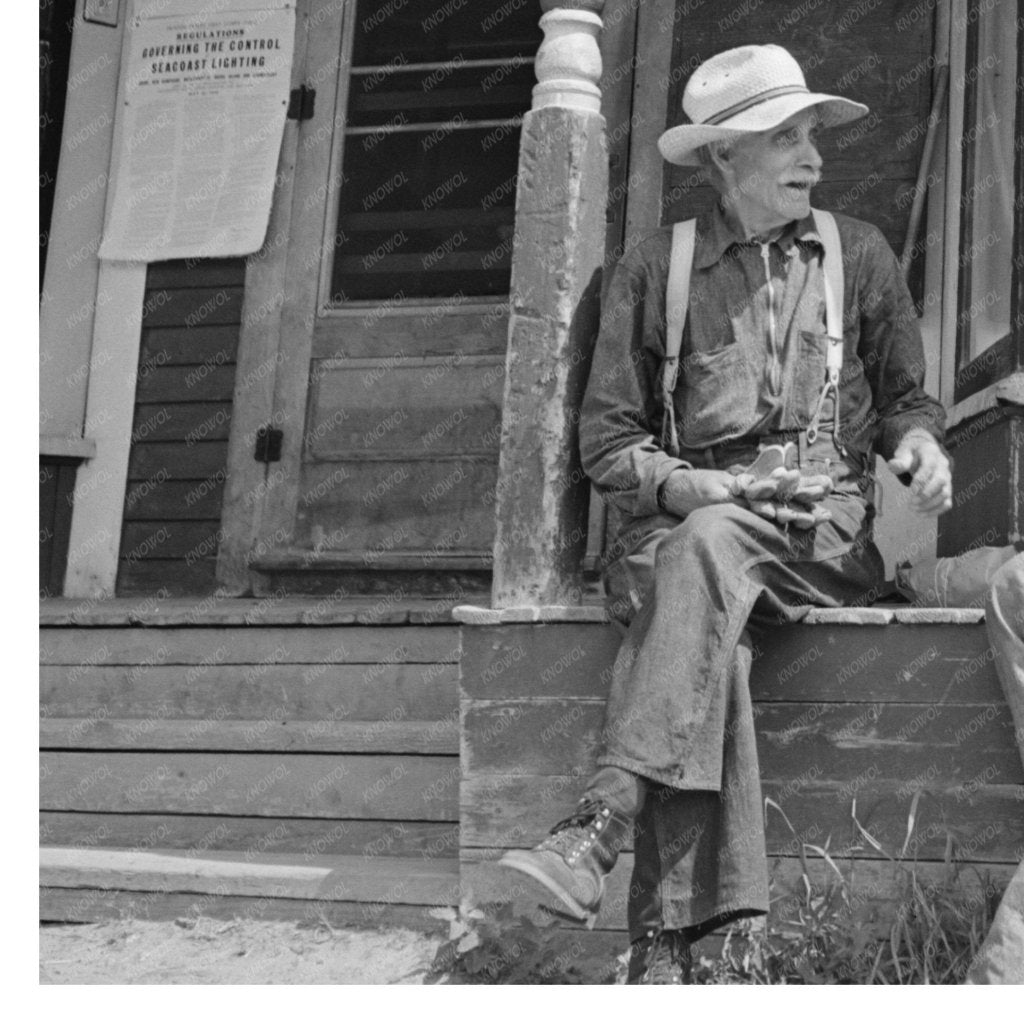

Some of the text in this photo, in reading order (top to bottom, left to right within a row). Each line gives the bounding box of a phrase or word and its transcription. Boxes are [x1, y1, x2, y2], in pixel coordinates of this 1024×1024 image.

[176, 29, 245, 40] REGULATIONS
[142, 38, 281, 59] GOVERNING THE CONTROL
[151, 56, 266, 74] SEACOAST LIGHTING
